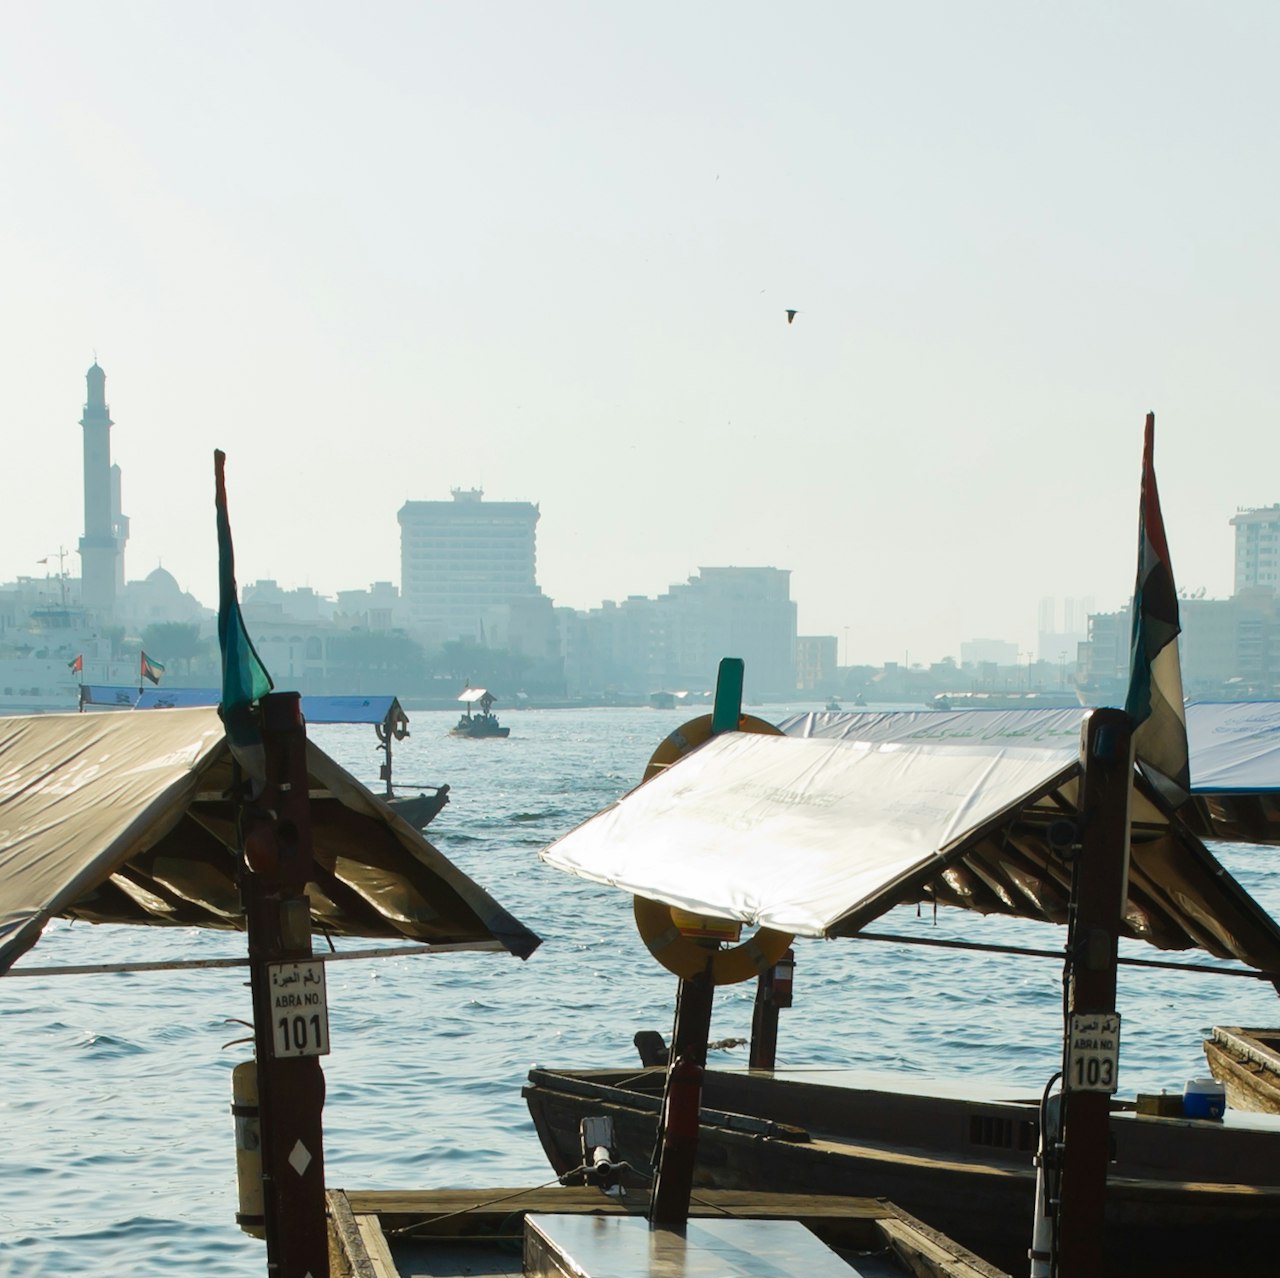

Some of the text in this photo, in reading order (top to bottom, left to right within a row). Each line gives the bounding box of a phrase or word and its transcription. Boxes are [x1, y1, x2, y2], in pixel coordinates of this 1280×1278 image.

[272, 968, 321, 987] رقم العبرة
[275, 992, 322, 1008] ABRA NO.
[279, 1014, 321, 1051] 101
[1074, 1039, 1098, 1050] ABRA
[1075, 1057, 1113, 1086] 103
